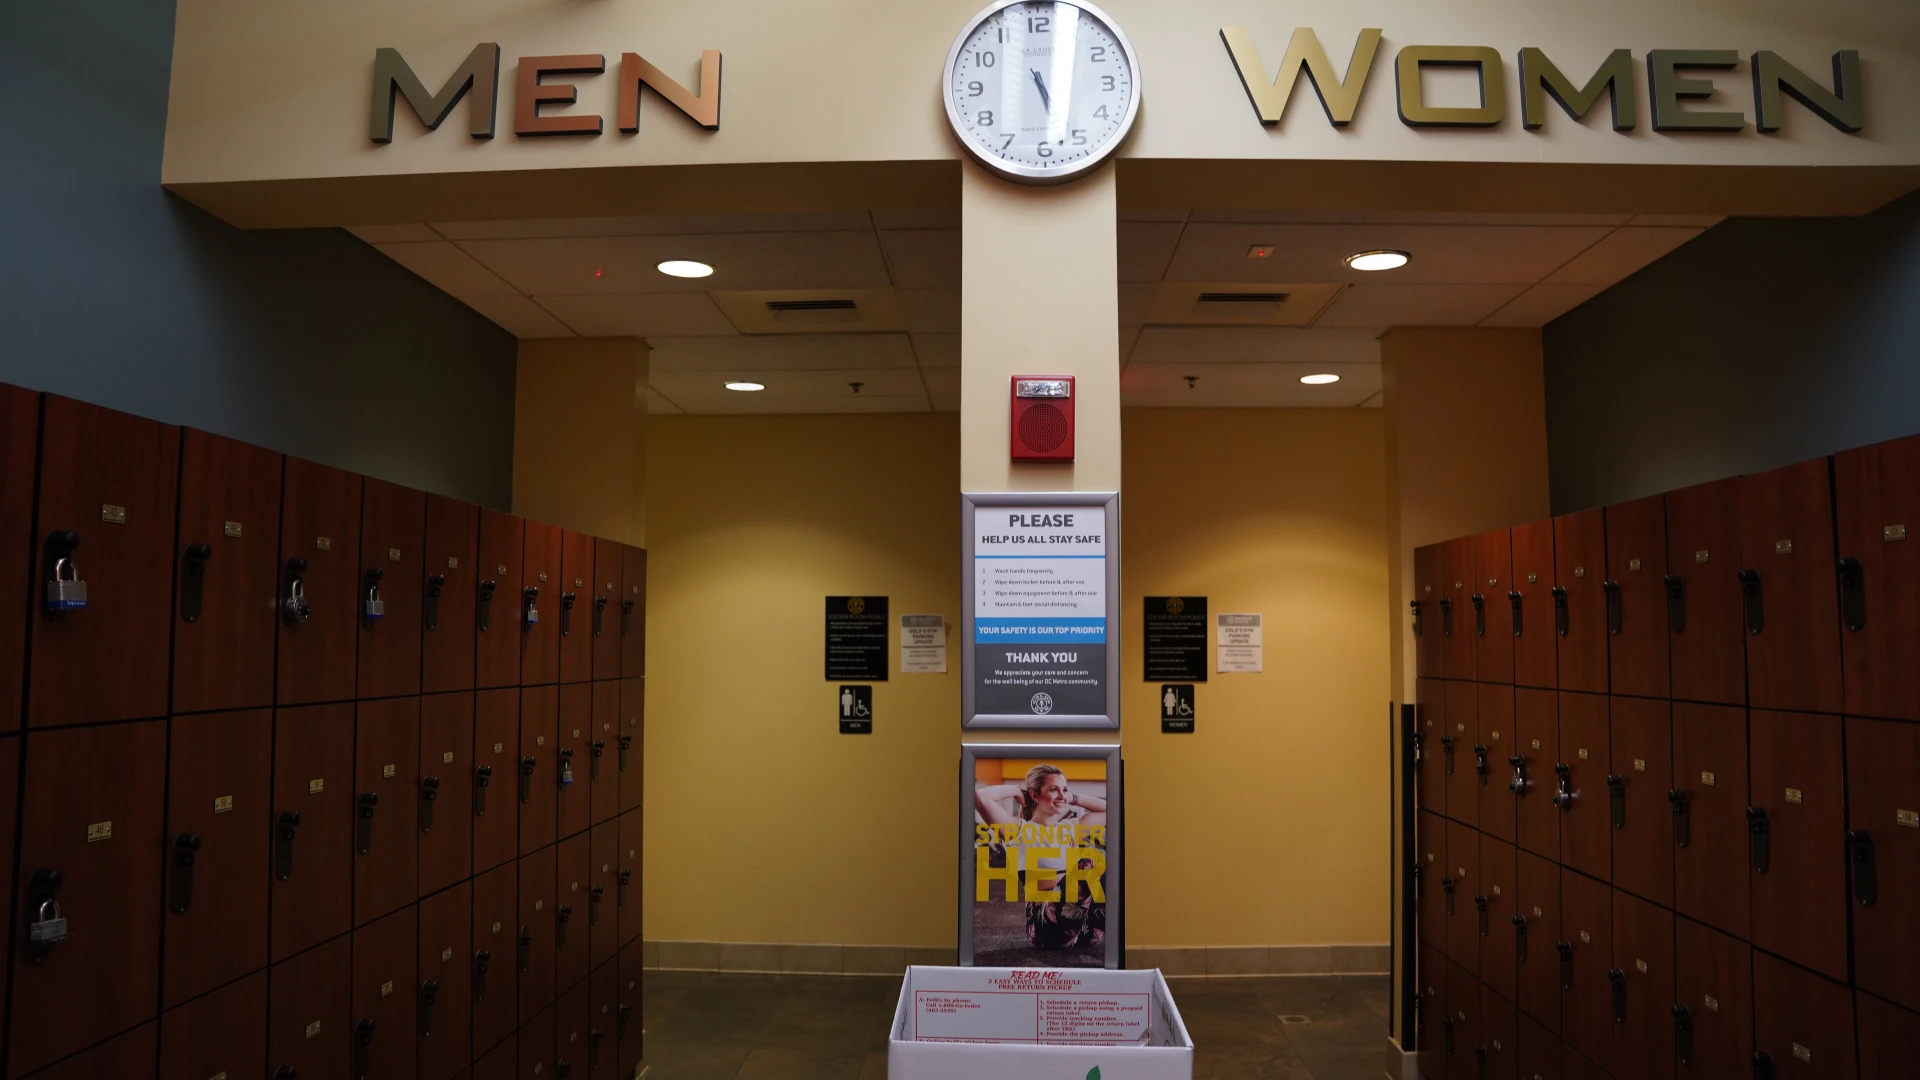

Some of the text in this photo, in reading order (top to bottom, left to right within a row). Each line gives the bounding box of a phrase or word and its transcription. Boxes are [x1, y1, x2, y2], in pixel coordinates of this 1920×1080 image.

[1027, 17, 1050, 34] 12
[998, 28, 1010, 44] 11
[975, 51, 996, 68] 10
[1090, 46, 1106, 62] 2
[1101, 75, 1116, 92] 3
[1218, 26, 1864, 134] WOMEN
[369, 41, 722, 144] MEN
[967, 81, 984, 98] 9
[977, 110, 994, 126] 8
[1092, 104, 1110, 120] 4
[1000, 134, 1016, 150] 7
[1072, 129, 1088, 146] 5
[1036, 141, 1053, 158] 6
[1009, 514, 1074, 528] PLEASE
[982, 535, 1101, 544] HELP US ALL STAY SAFE
[1026, 568, 1054, 576] frequently
[979, 627, 1104, 635] YOUR SAFETY IS OUR TOP PRIORITY
[1006, 652, 1078, 663] THANK YOU
[975, 824, 1106, 846] STRONGER
[976, 846, 1106, 904] HER
[1010, 970, 1064, 981] READ ME!
